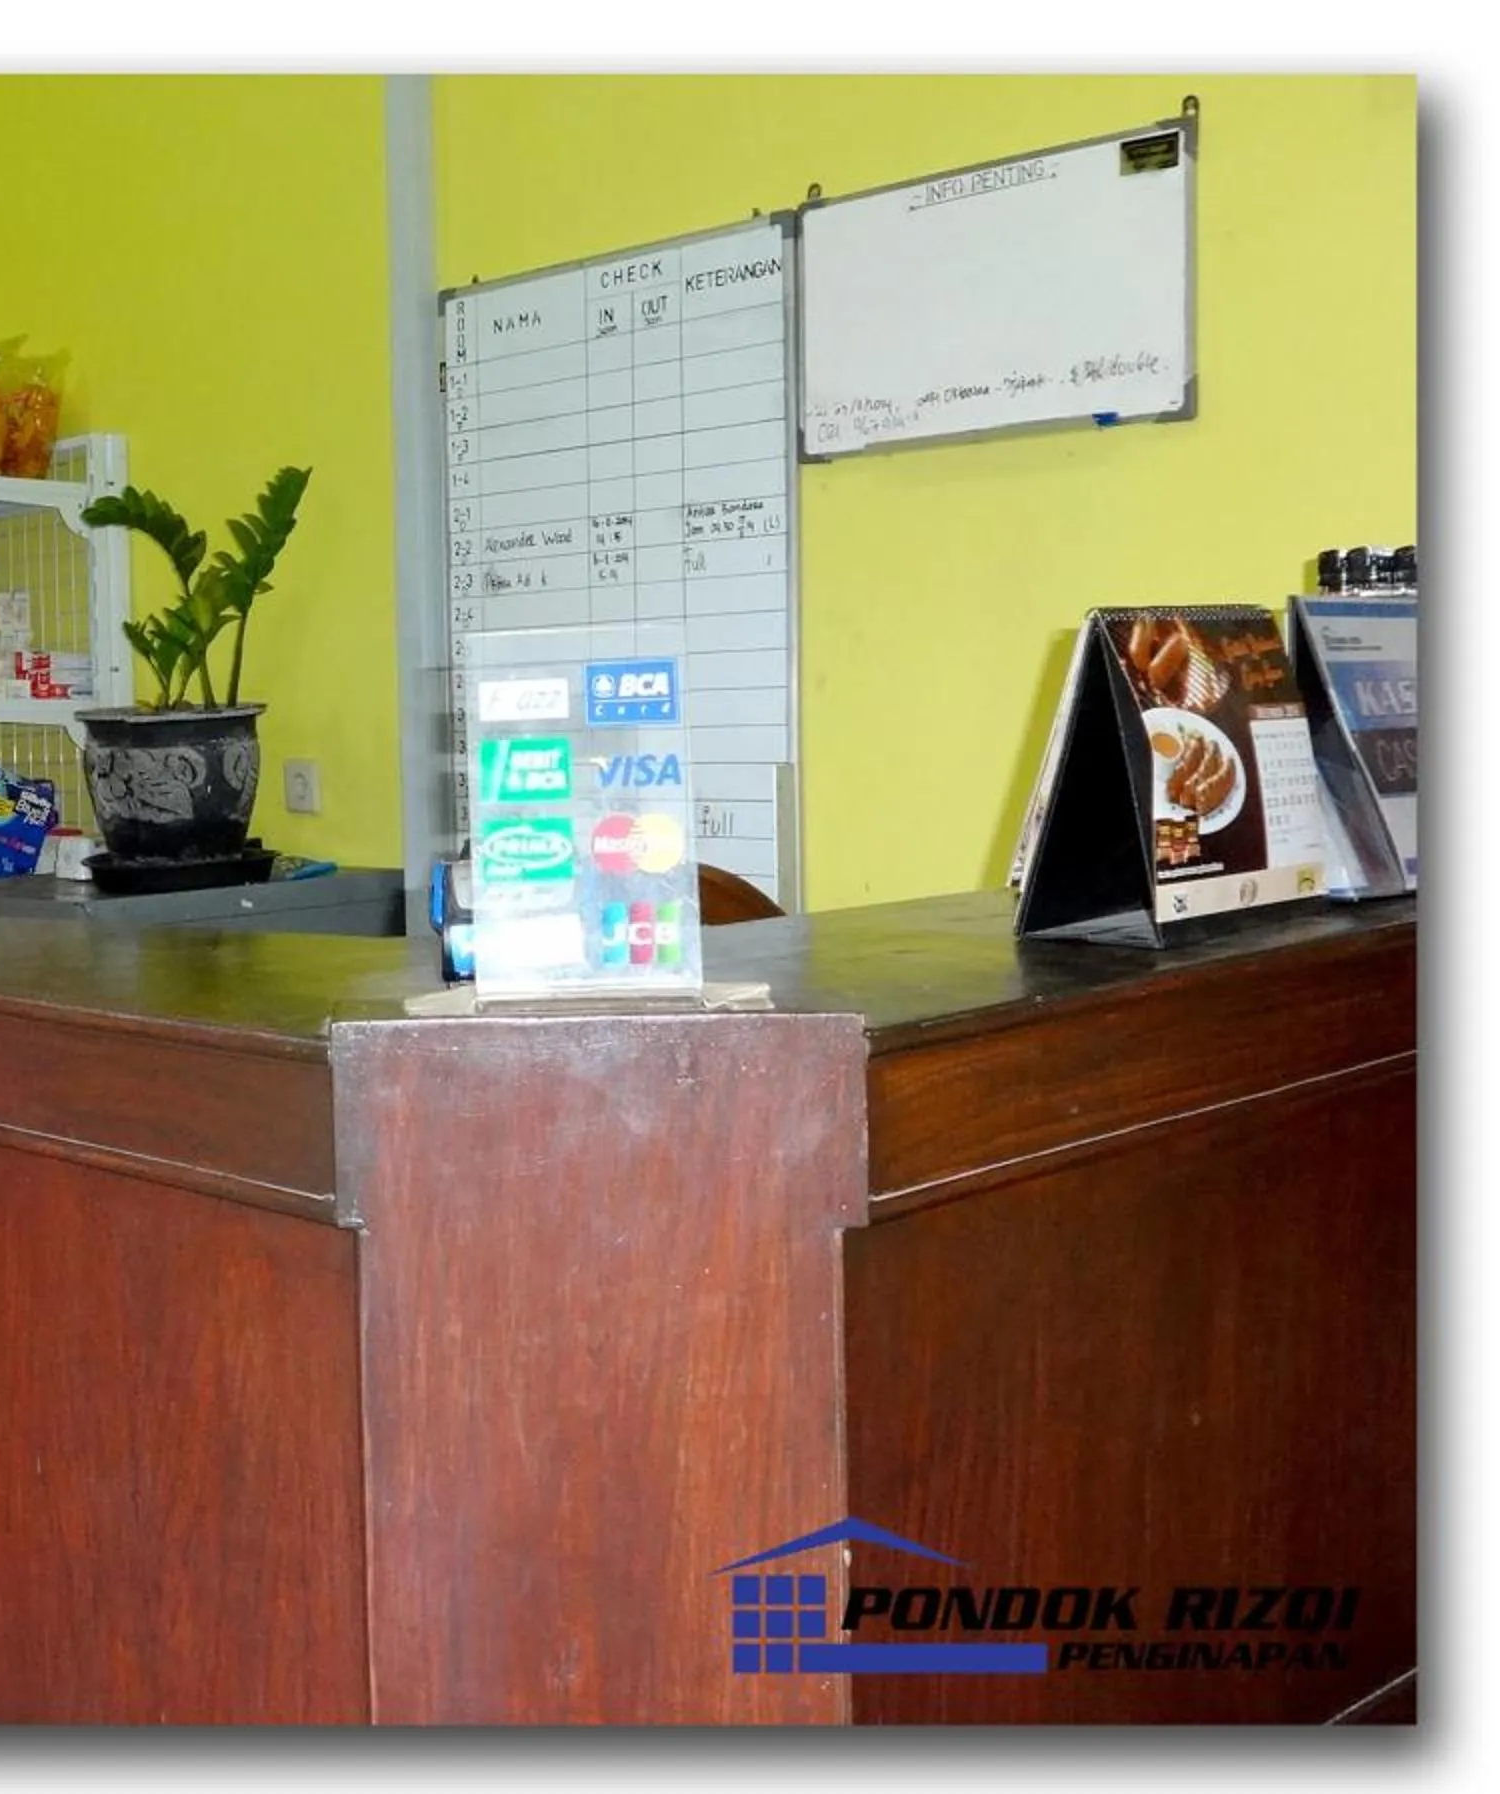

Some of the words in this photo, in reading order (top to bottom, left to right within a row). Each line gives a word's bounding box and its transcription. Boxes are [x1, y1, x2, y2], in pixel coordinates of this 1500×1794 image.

[925, 178, 965, 203] INFO
[970, 159, 1046, 193] PENTING
[600, 260, 664, 289] CHECK
[685, 257, 782, 293] KETERANGAN
[599, 307, 615, 325] IN
[640, 296, 668, 318] OUT
[493, 311, 543, 334] NAMA
[618, 672, 670, 697] BCA
[591, 753, 682, 787] VISA
[601, 922, 681, 946] JCB
